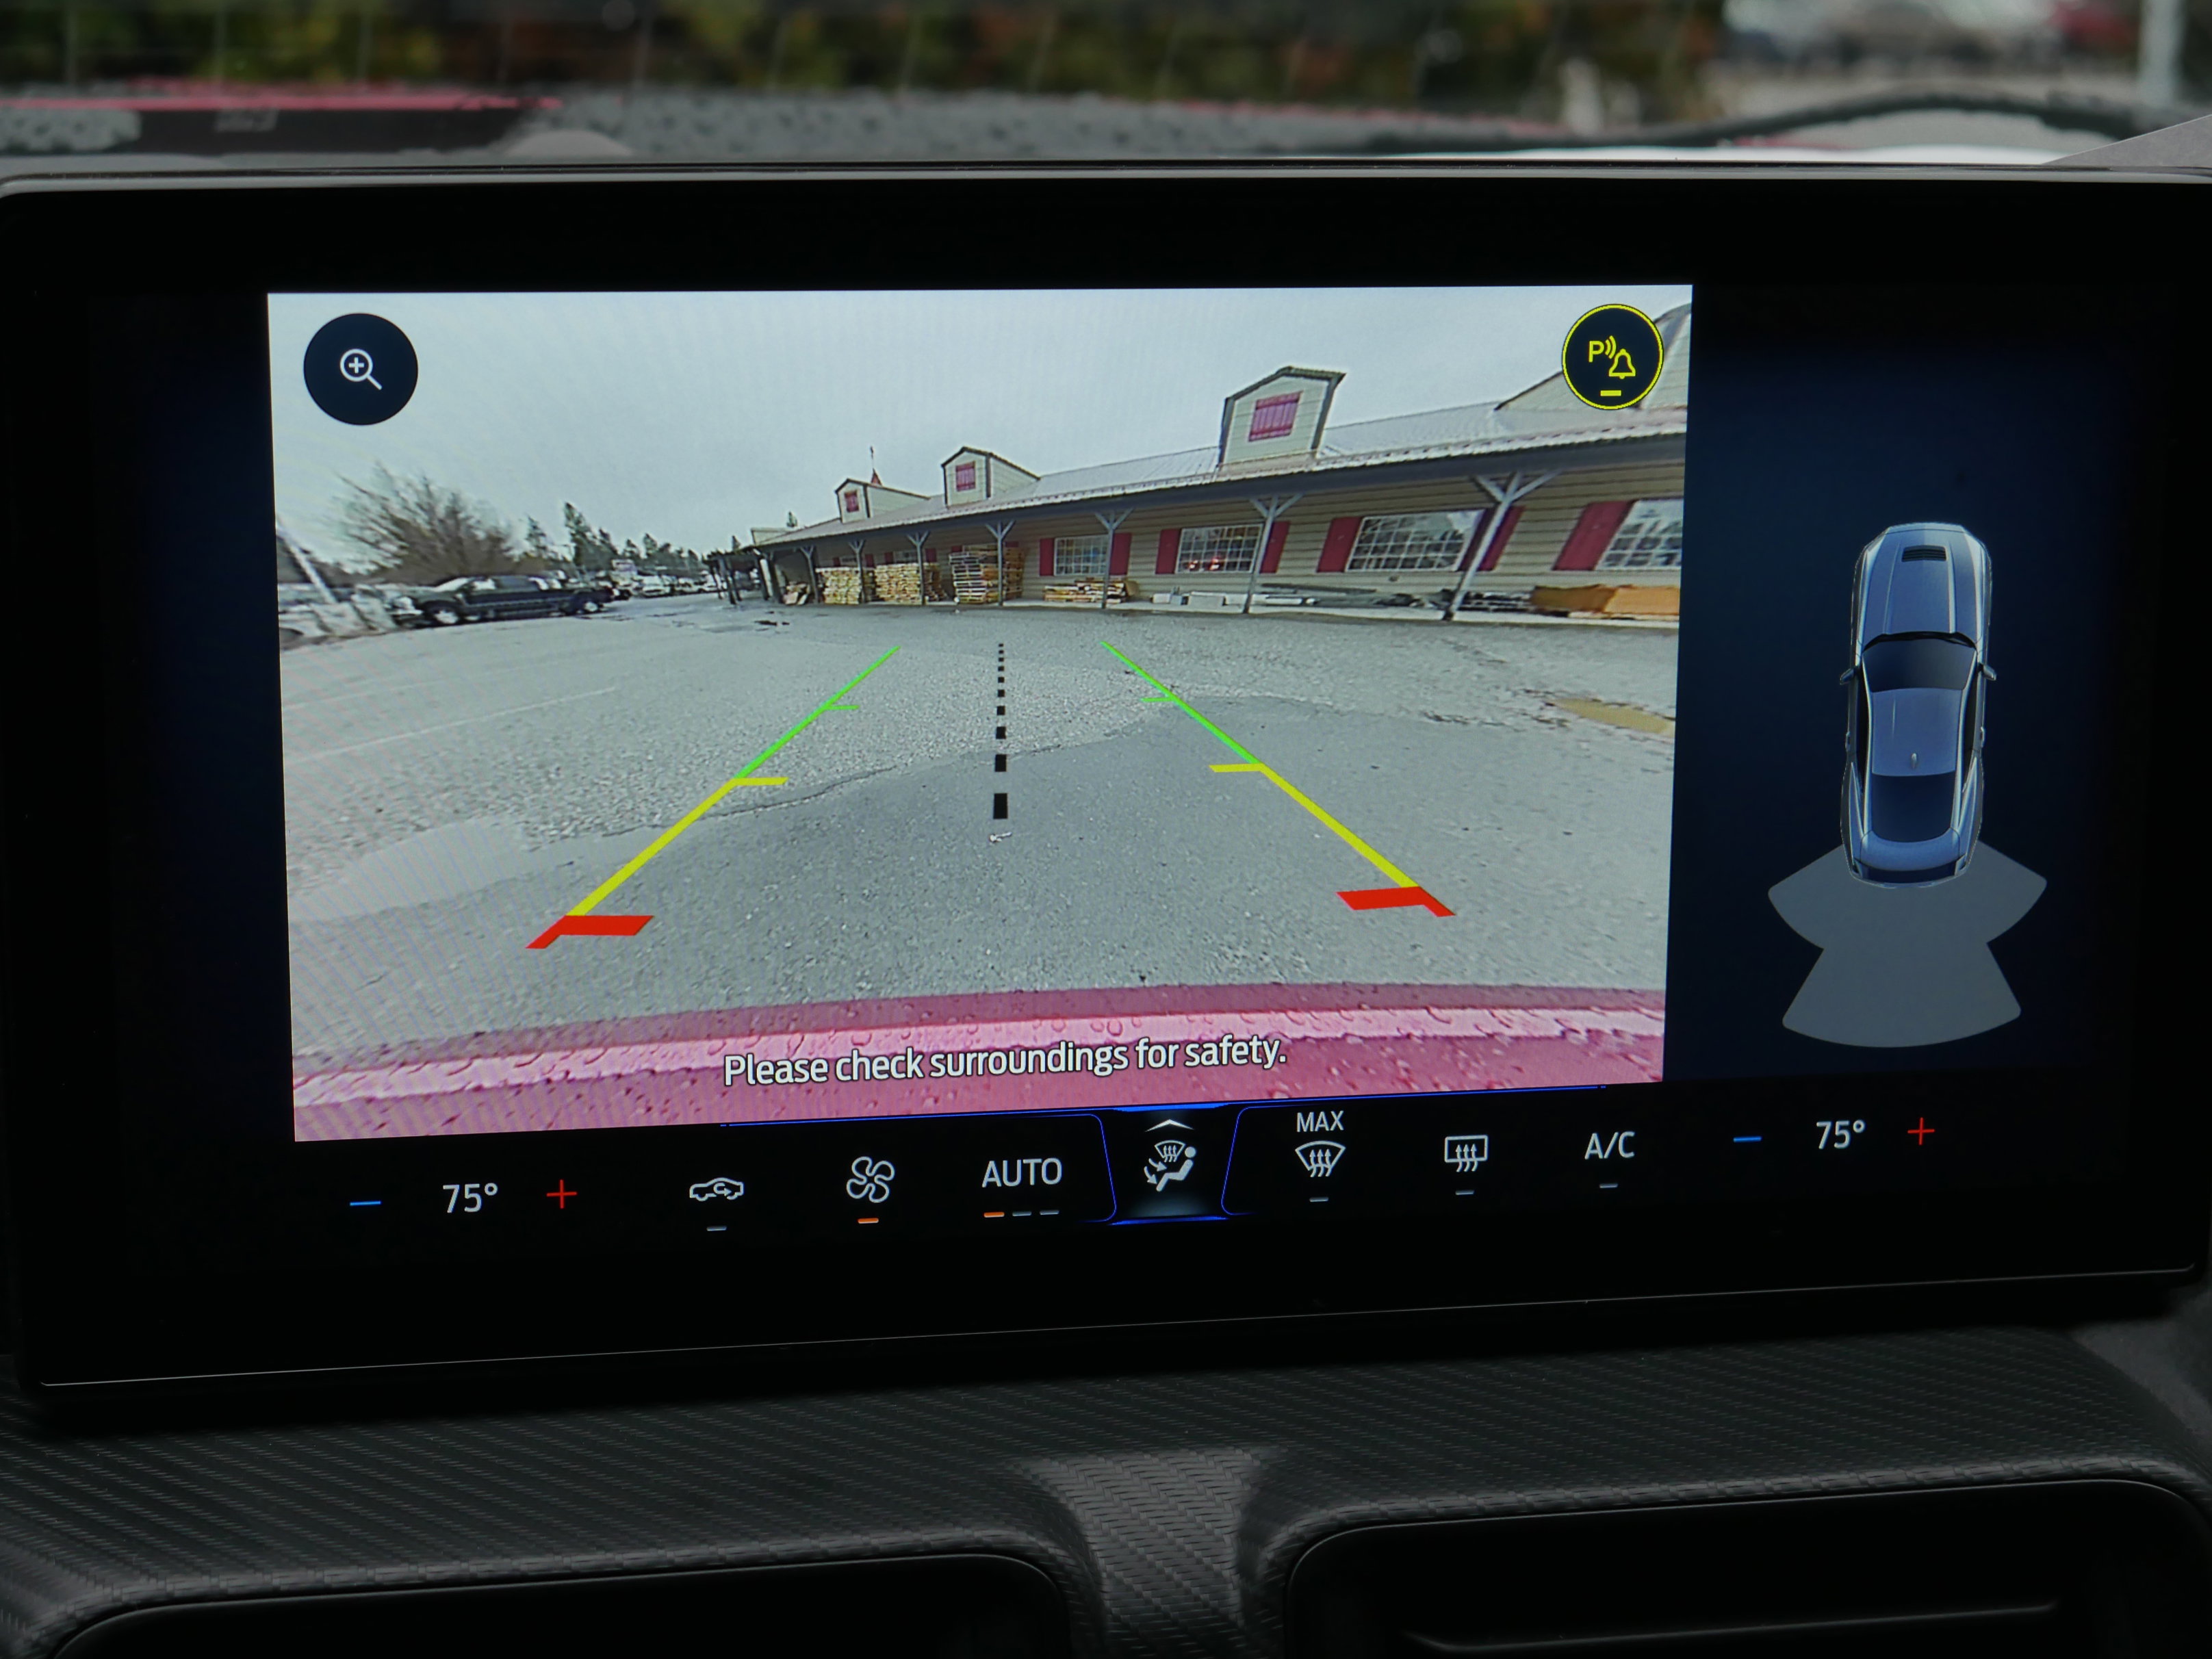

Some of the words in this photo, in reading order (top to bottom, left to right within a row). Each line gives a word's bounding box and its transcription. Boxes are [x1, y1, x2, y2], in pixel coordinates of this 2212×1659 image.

[1589, 340, 1605, 363] P
[724, 1053, 829, 1086] Please
[835, 1047, 925, 1081] check
[929, 1040, 1129, 1078] surroundings
[1135, 1037, 1180, 1070] for
[1184, 1033, 1287, 1070] safety.
[1296, 1110, 1343, 1133] MAX
[1816, 1120, 1865, 1149] 75°
[1584, 1131, 1635, 1160] A/C
[981, 1157, 1062, 1188] AUTO
[442, 1183, 498, 1213] 75°
